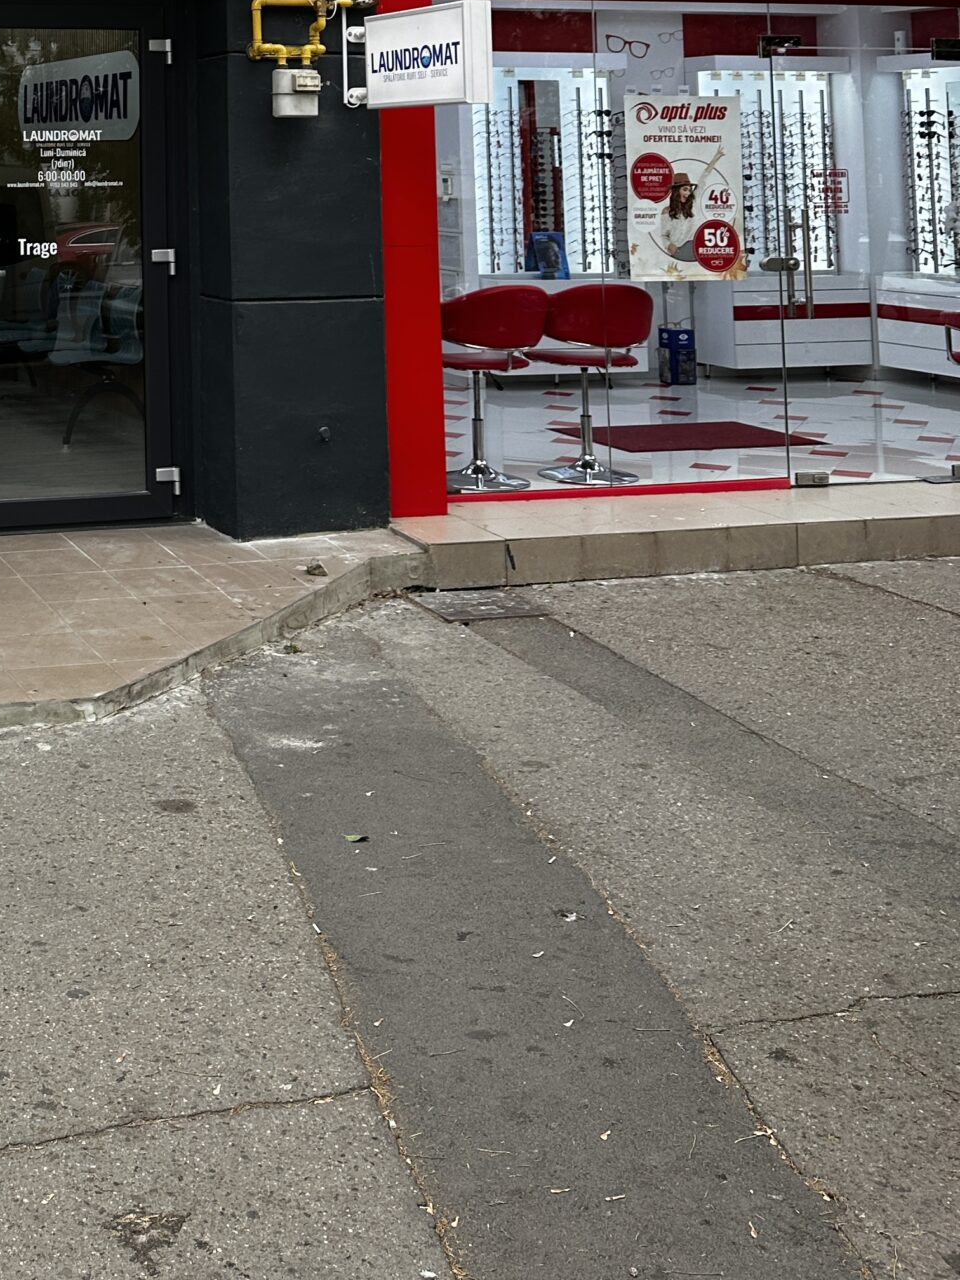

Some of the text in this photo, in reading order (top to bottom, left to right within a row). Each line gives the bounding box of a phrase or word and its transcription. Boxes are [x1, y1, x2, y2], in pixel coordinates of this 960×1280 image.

[371, 41, 461, 74] LAUNDROMAT
[23, 71, 132, 124] LAUNDROMAT
[660, 103, 728, 122] opti plus
[23, 130, 102, 142] LAUNDROMAT
[643, 135, 683, 143] OFERTELE
[38, 171, 86, 182] 6:00-00:00
[18, 237, 58, 259] Trage
